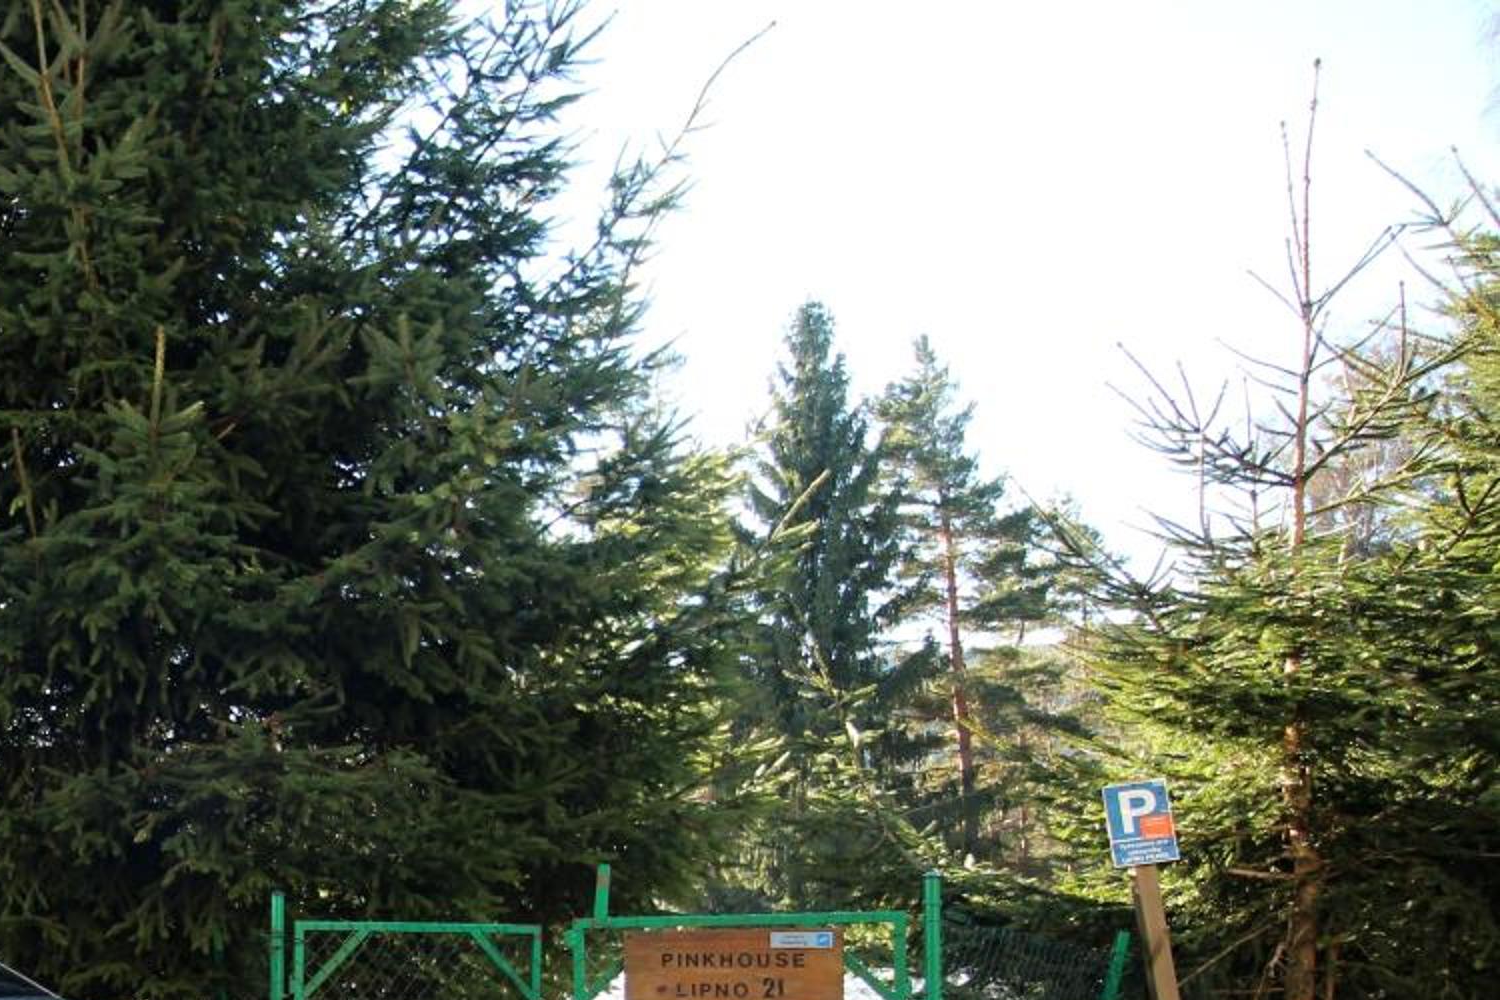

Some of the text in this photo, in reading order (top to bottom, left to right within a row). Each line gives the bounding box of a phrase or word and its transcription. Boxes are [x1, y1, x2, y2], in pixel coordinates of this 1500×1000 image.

[1118, 789, 1156, 834] P
[661, 953, 805, 968] PINKHOUSE
[676, 978, 785, 998] LIPNO 21
